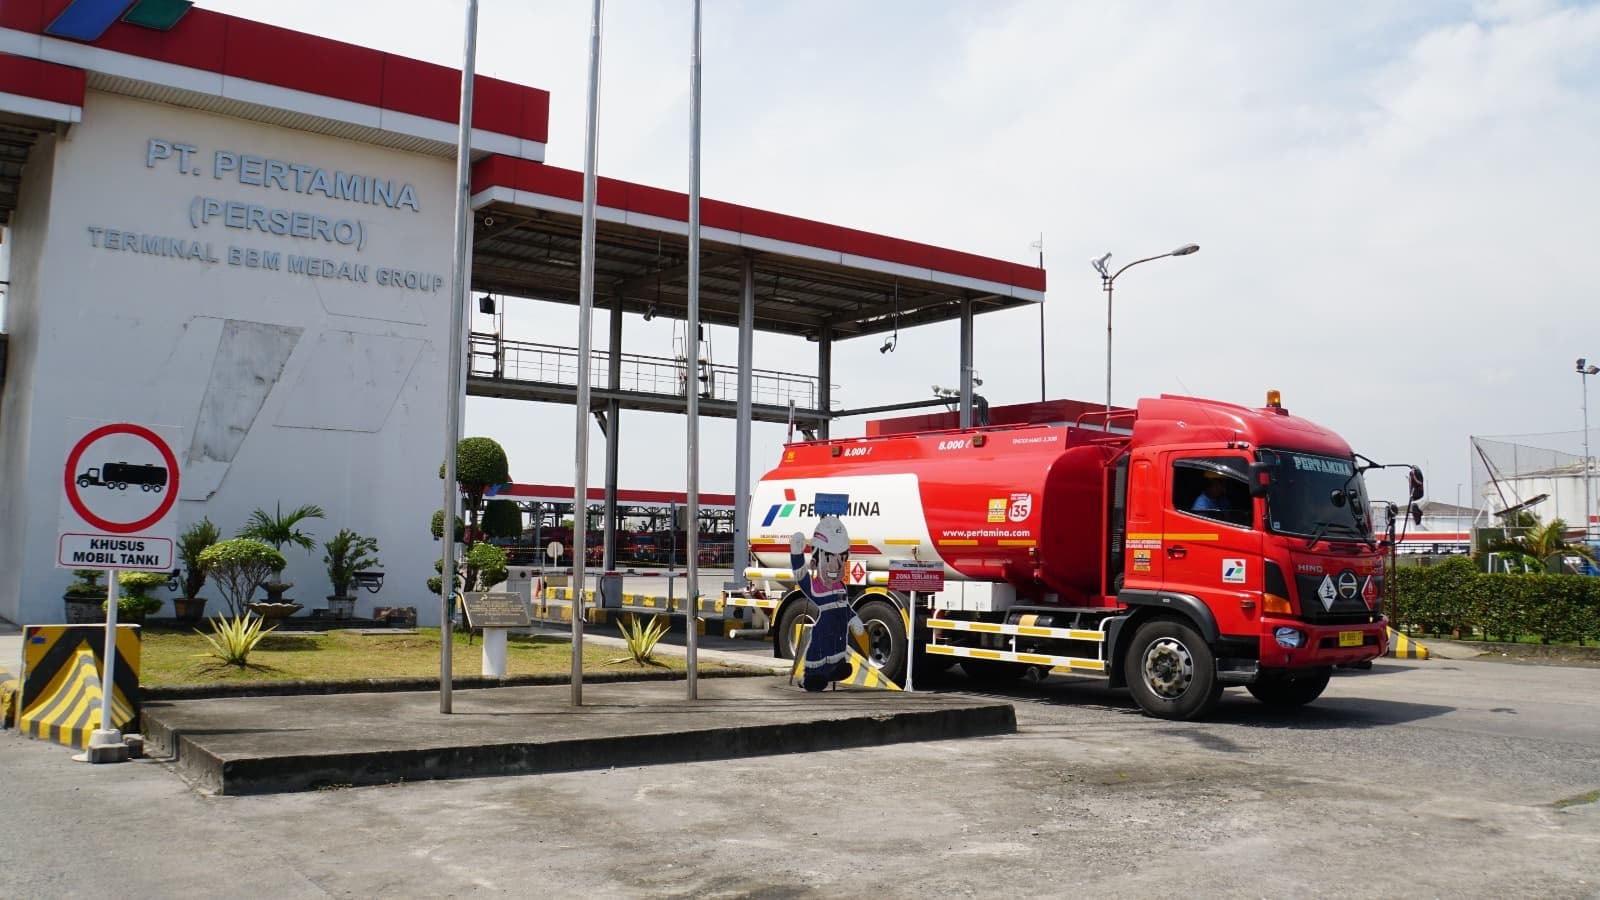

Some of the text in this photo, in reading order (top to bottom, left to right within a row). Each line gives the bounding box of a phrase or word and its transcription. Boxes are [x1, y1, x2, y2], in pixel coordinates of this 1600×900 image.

[146, 138, 421, 212] PT. PERTAMINA
[190, 196, 367, 252] (PERSERO)
[87, 226, 445, 293] TERMINAL BBM MEDAN GROUP
[938, 439, 964, 450] 8.000
[1292, 455, 1353, 477] PERTAMINA
[942, 528, 1030, 539] www.pertamina.com
[90, 538, 145, 552] KHUSUS
[72, 551, 159, 566] MOBIL TANKI
